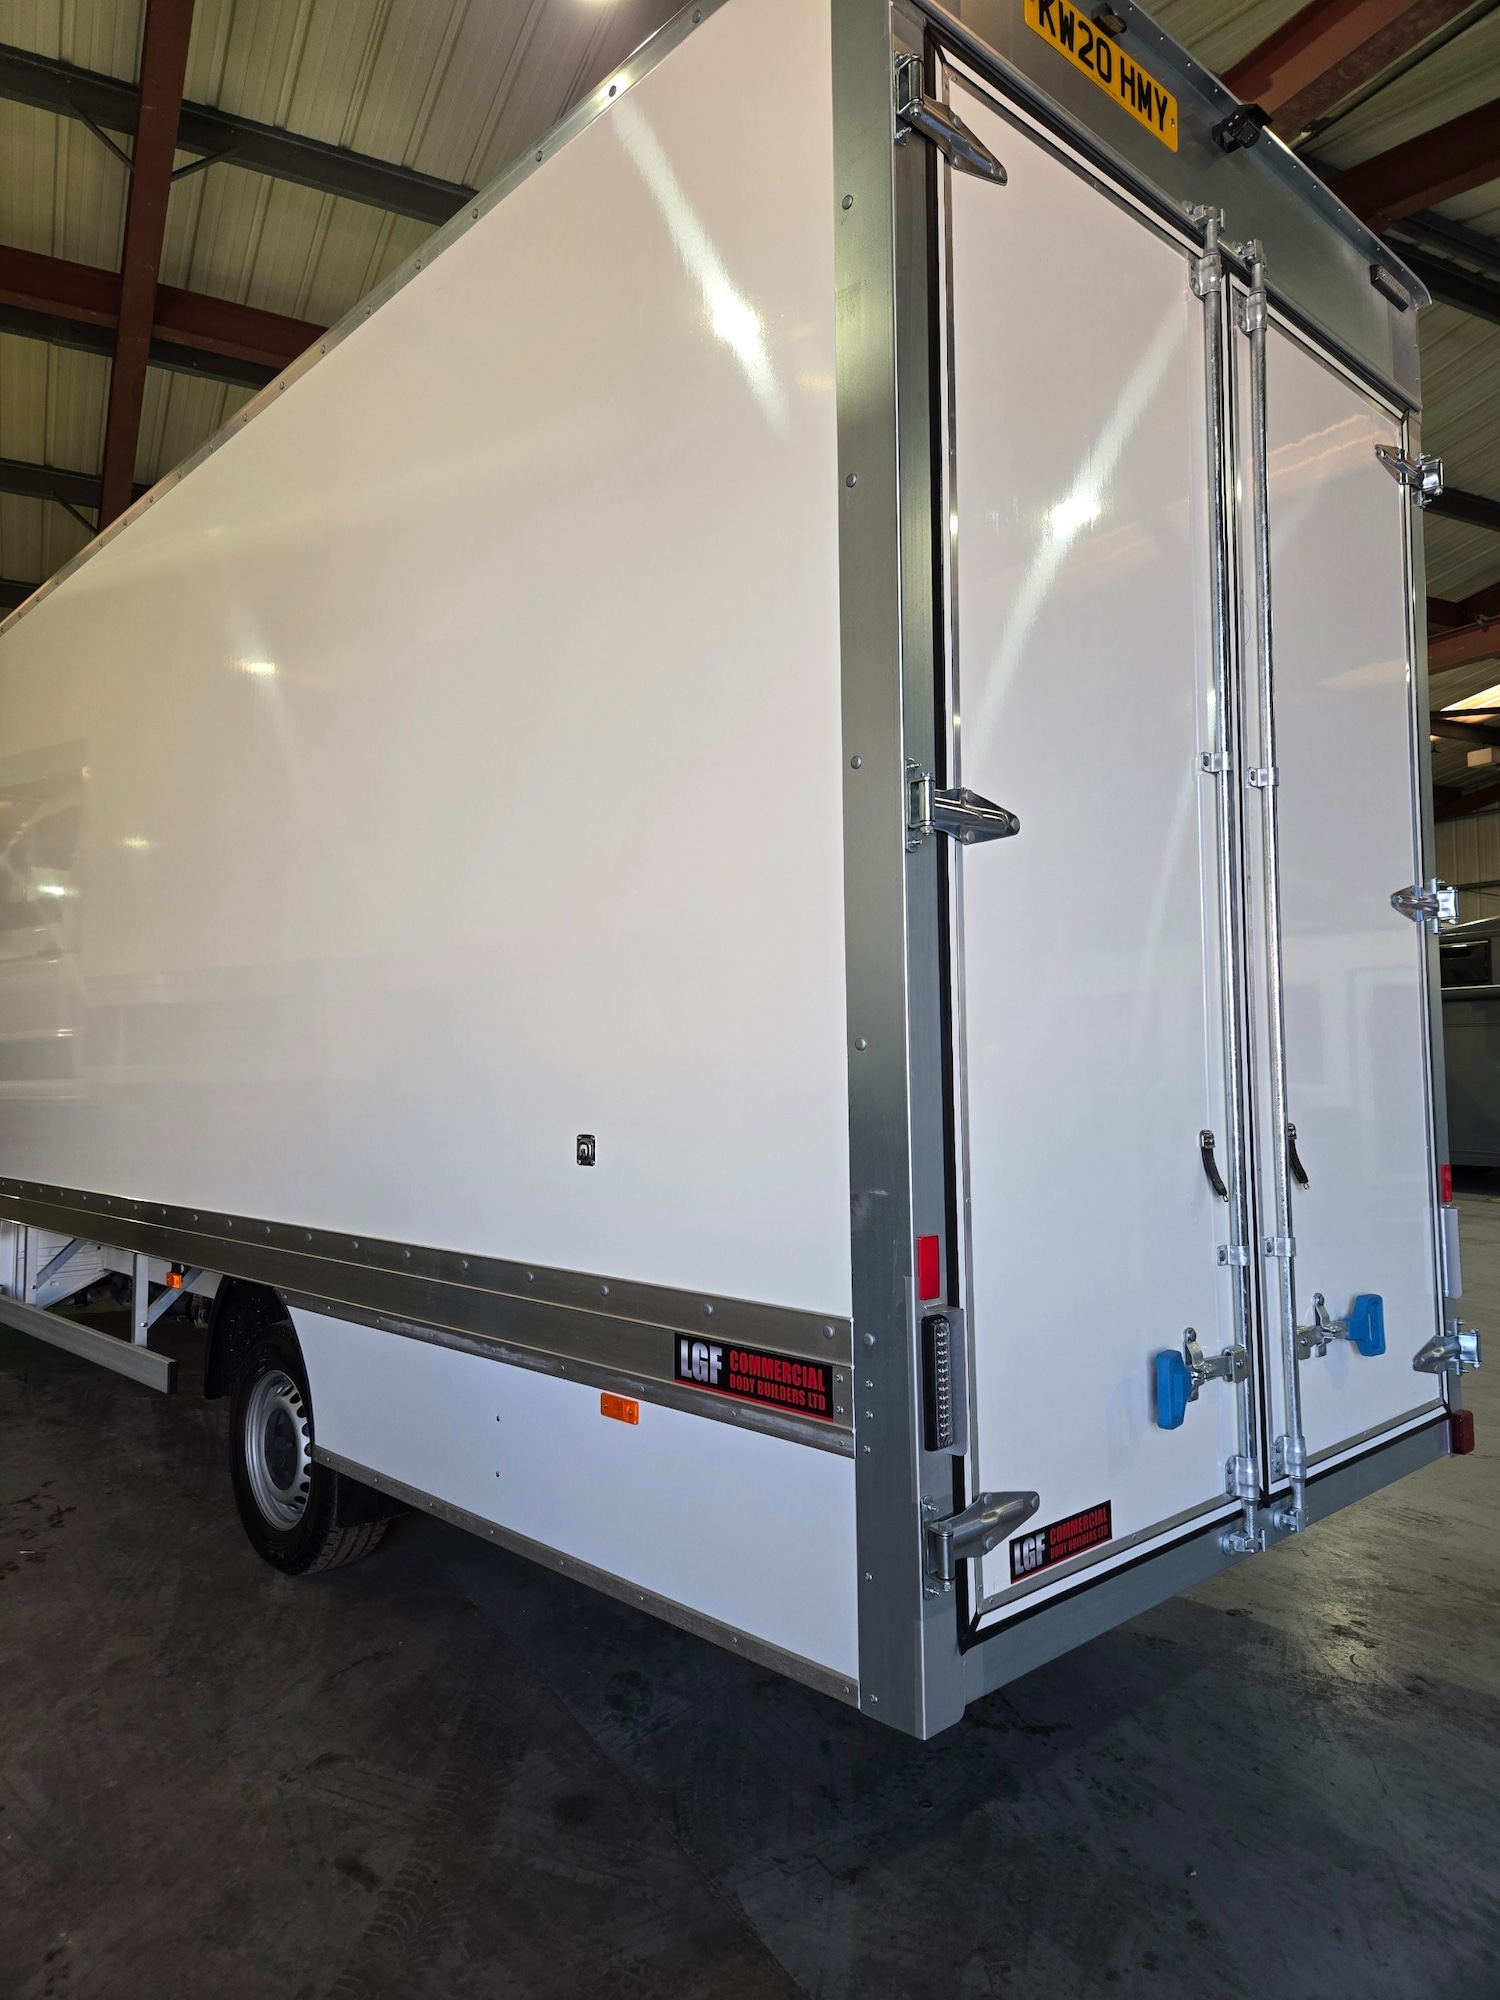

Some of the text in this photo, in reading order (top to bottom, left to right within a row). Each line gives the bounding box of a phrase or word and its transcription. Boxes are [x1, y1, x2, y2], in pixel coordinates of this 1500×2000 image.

[1038, 0, 1168, 132] KW20 HMY
[680, 1339, 723, 1385] LGF
[729, 1350, 825, 1392] COMMERCIAL
[729, 1374, 826, 1411] BODY BUILDERS LTD
[1049, 1507, 1108, 1545] COMMERCIAL
[1050, 1524, 1109, 1560] BODY BUILDERS LTD
[1014, 1532, 1046, 1576] LGF
